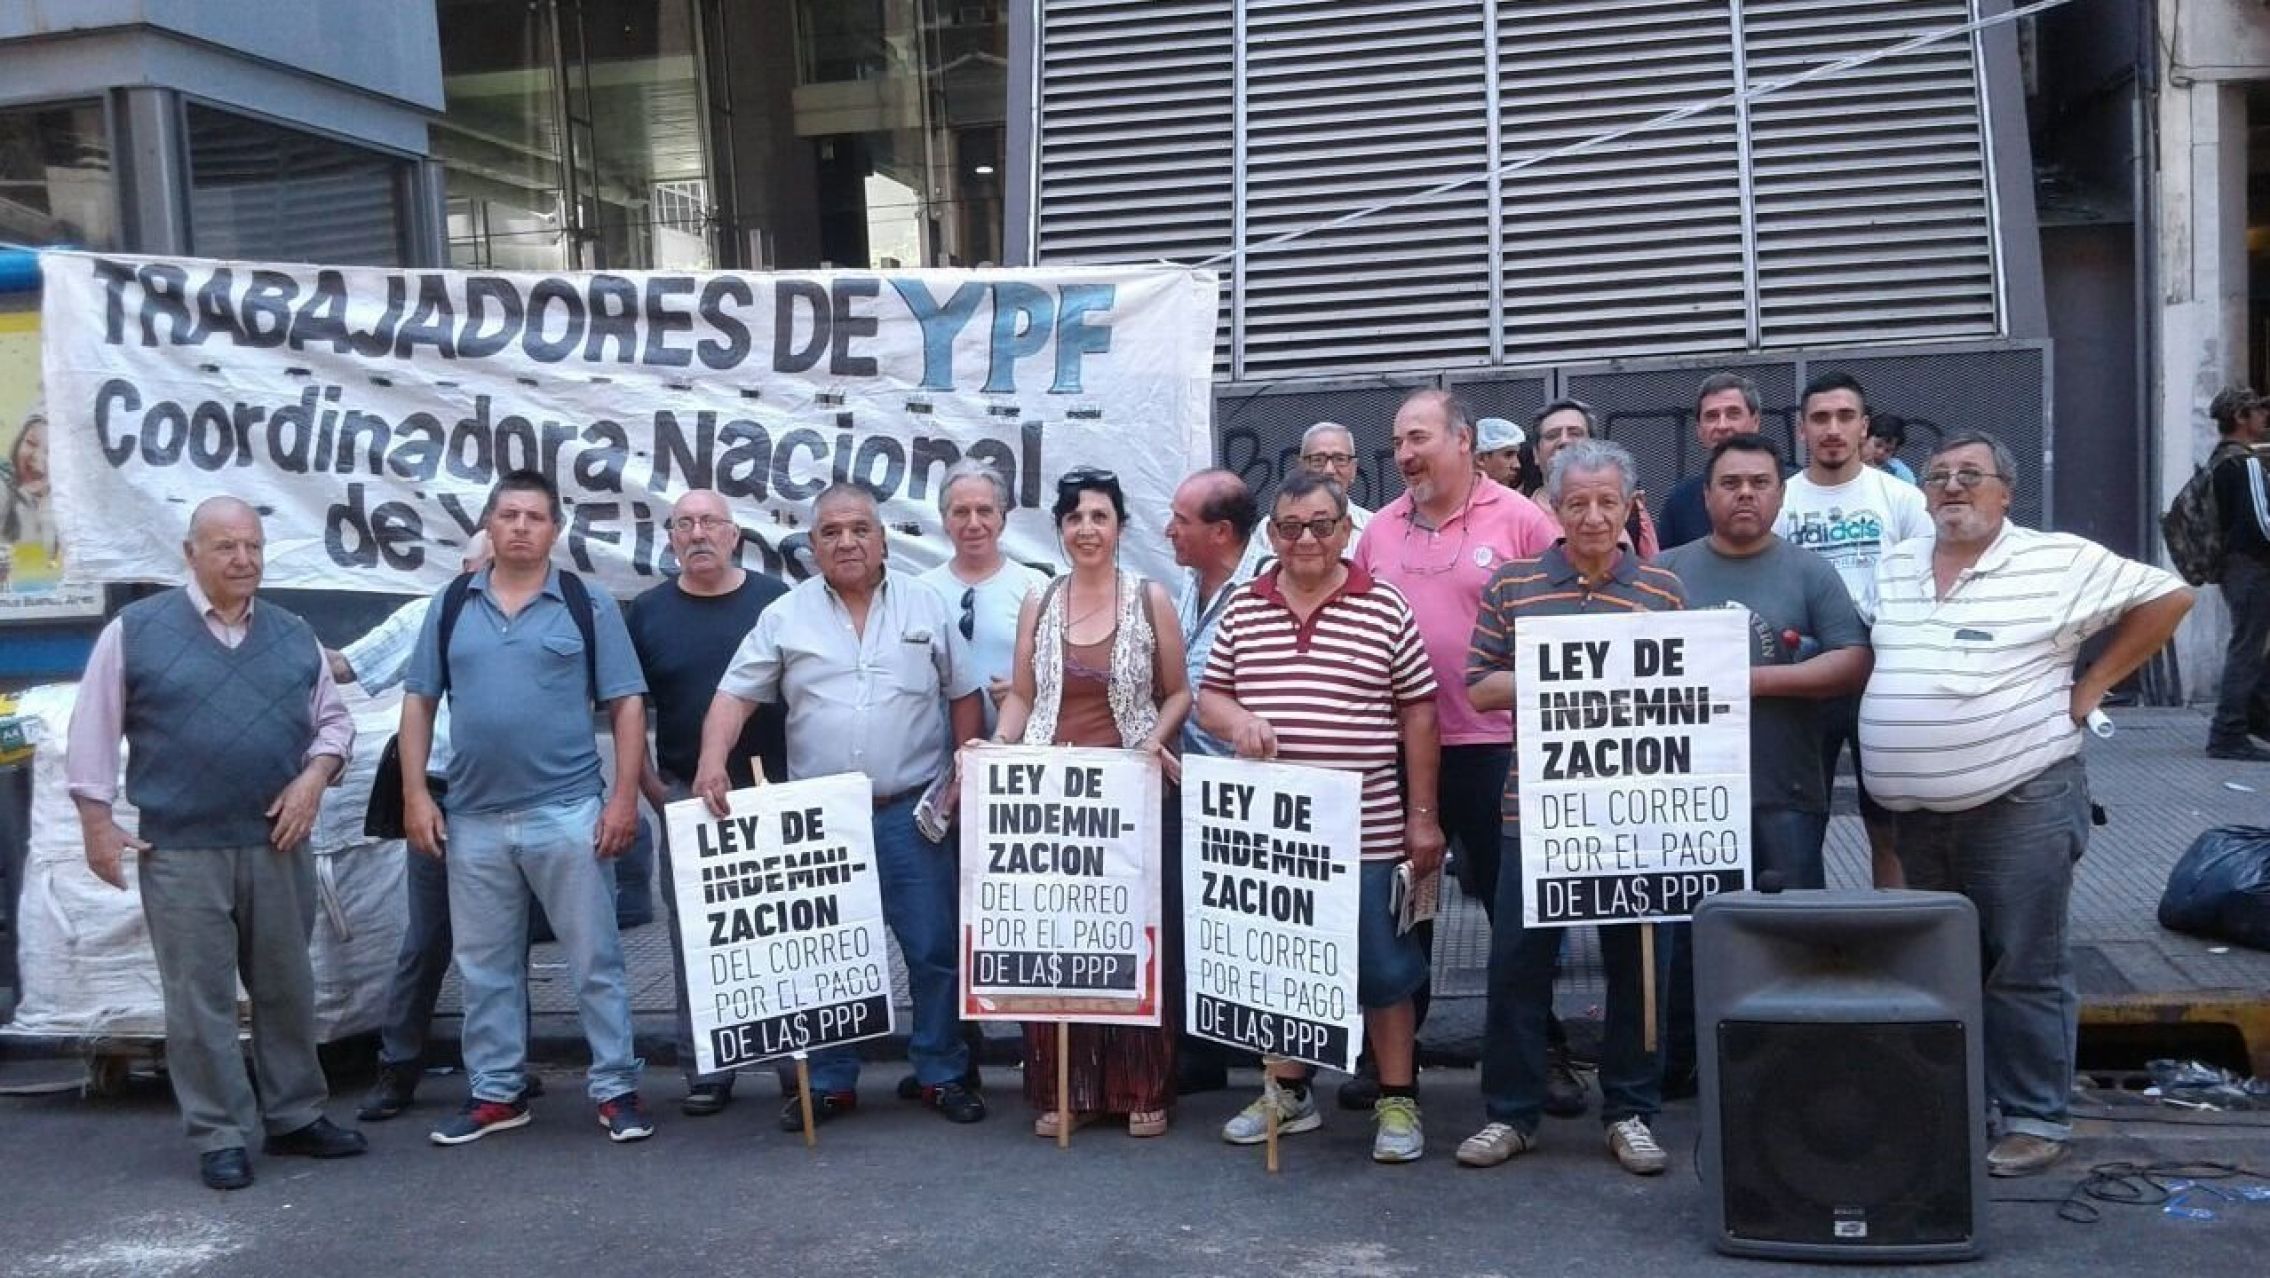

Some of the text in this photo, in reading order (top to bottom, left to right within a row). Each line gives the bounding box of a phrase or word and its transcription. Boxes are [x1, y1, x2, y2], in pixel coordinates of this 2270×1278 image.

[94, 258, 1116, 394] TRABAJADORES DE YPF
[95, 378, 628, 493] Coordinadora
[325, 483, 425, 571] de
[1539, 638, 1684, 682] LEY DE
[1540, 686, 1730, 732] INDEMNI-
[989, 764, 1103, 798] LEY DE
[1542, 736, 1690, 780] ZACION
[697, 807, 824, 857] LEY DE
[989, 803, 1135, 838] INDEMNI-
[1202, 780, 1311, 833] LEY DE
[1542, 786, 1729, 829] DEL CORREO
[702, 847, 866, 904] INDEMNI-
[988, 842, 1104, 877] ZACION
[1202, 825, 1346, 881] INDEMNI-
[1545, 830, 1738, 873] POR EL PAGO
[707, 894, 839, 946] ZACION
[981, 881, 1128, 915] DEL CORREO
[1202, 871, 1313, 926] ZACION
[1546, 881, 1583, 918] DE
[1662, 874, 1720, 911] PPP
[711, 927, 869, 985] DEL CORREO
[981, 918, 1133, 950] POR EL PAGO
[1200, 918, 1338, 977] DEL CORREO
[715, 964, 881, 1023] POR EL PAGO
[980, 954, 1009, 984] DE
[1072, 956, 1118, 986] PPP
[1201, 958, 1345, 1021] POR EL PAGO
[719, 1026, 753, 1063] DE
[818, 1002, 868, 1041] PPP
[1201, 998, 1226, 1036] DE
[1283, 1017, 1327, 1059] PPP
